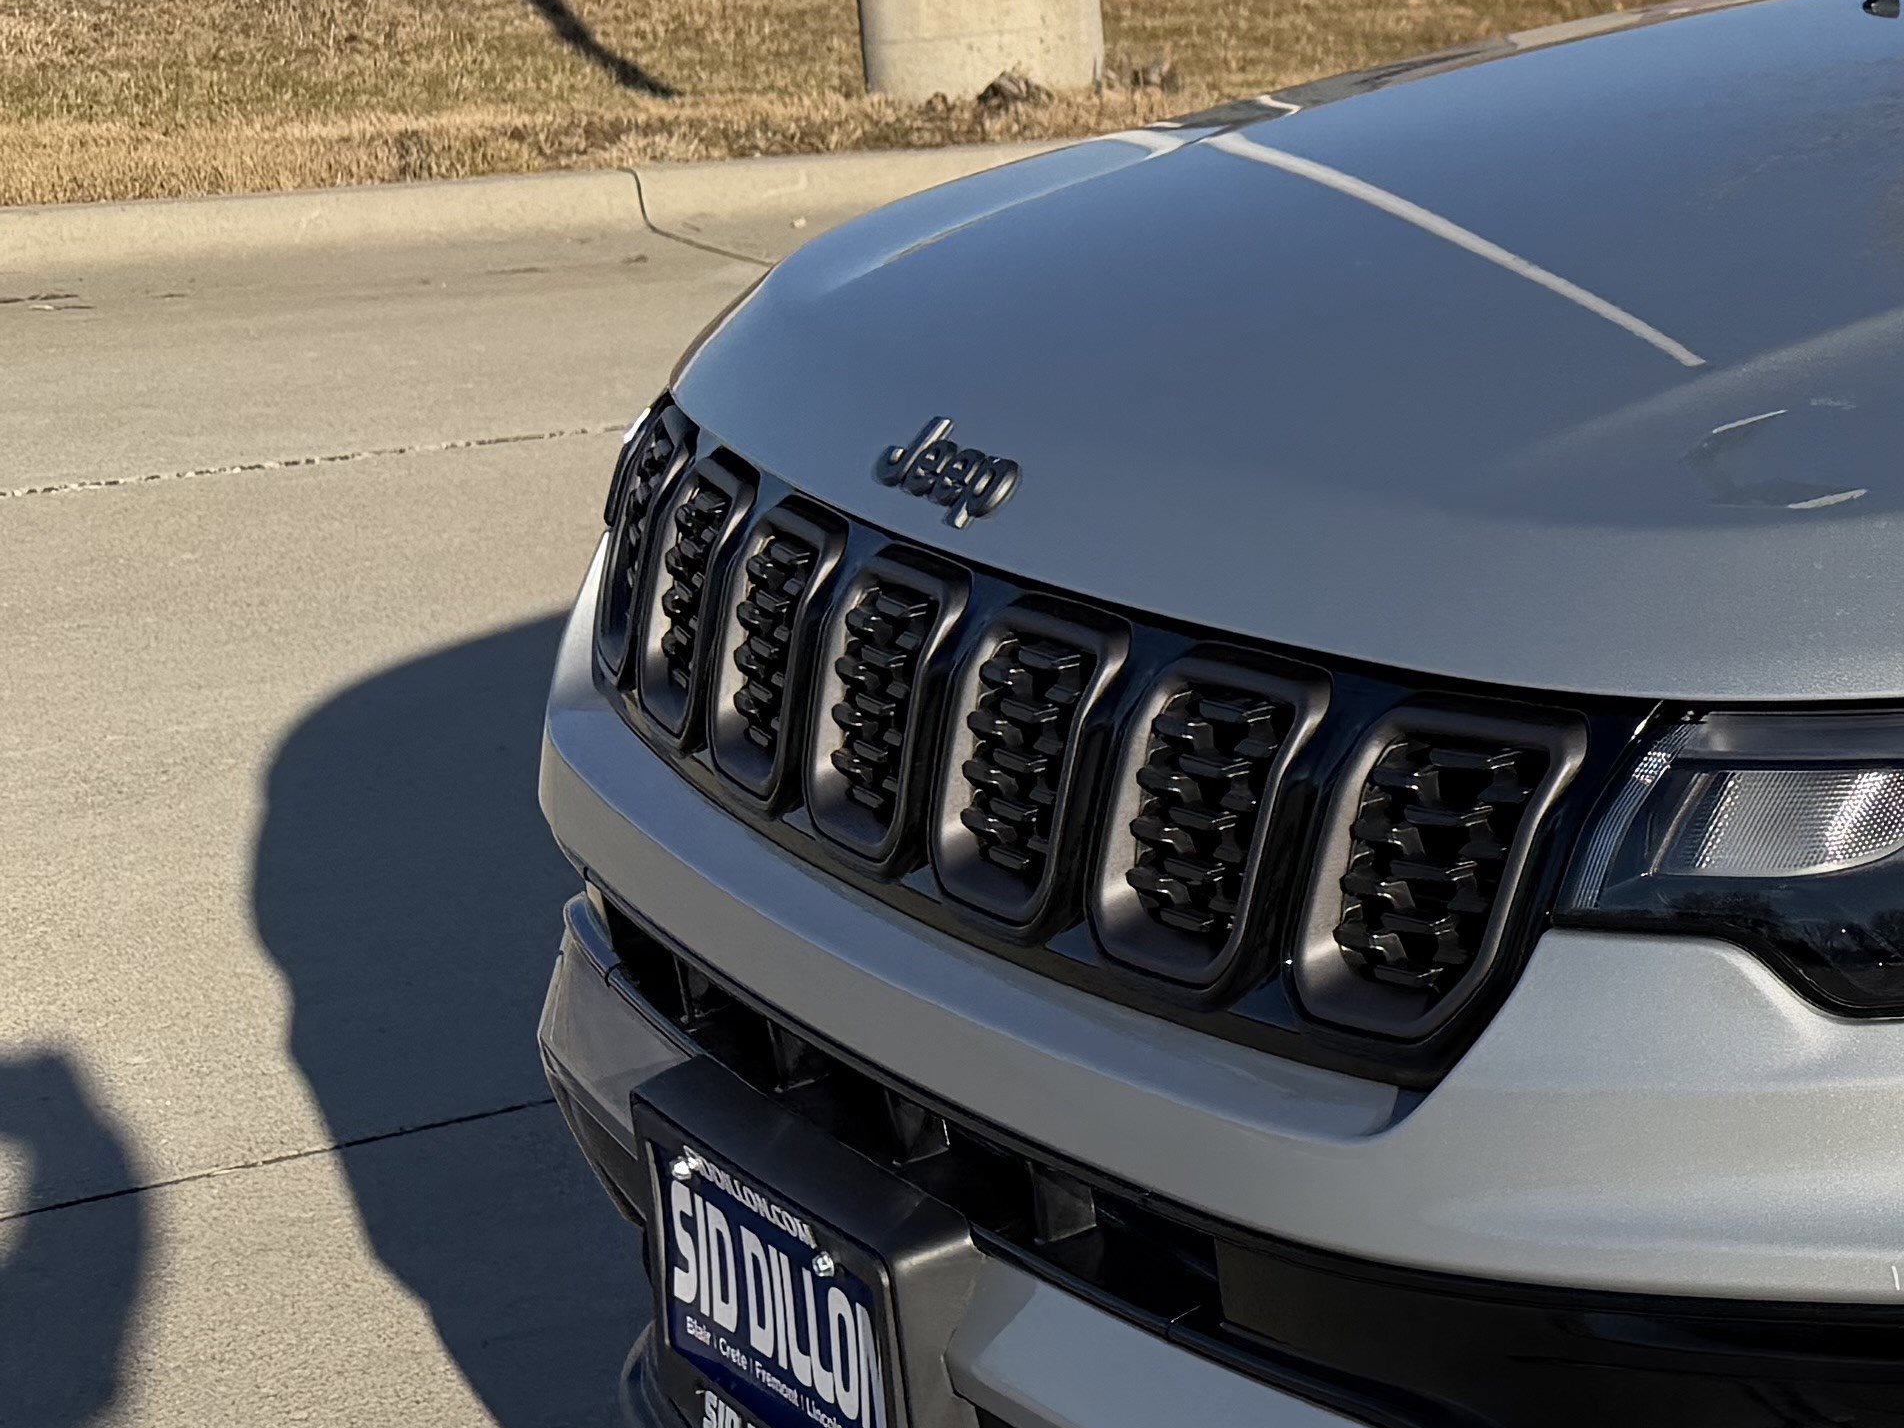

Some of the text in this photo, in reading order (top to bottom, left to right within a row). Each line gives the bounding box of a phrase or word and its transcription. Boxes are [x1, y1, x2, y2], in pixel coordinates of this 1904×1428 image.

[874, 416, 1022, 529] Jeep
[671, 1180, 738, 1333] SID
[718, 1336, 748, 1371] Crete
